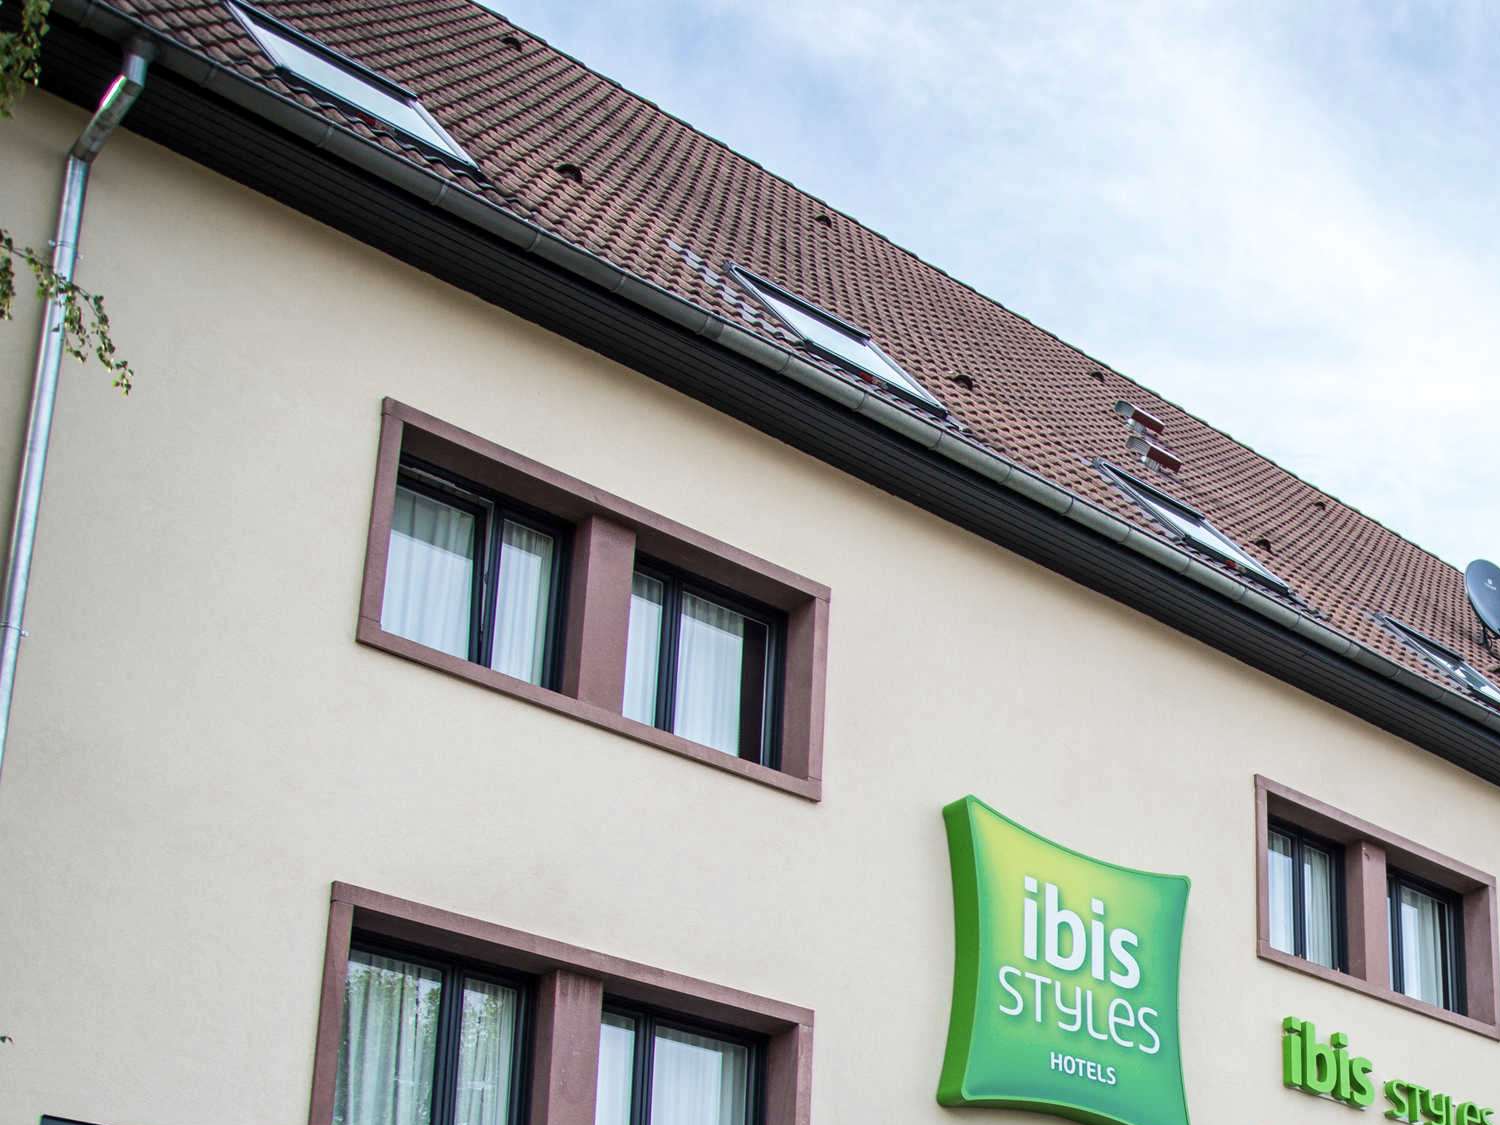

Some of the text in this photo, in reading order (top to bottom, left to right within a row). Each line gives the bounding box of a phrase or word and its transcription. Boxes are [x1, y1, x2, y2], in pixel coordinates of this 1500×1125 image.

[1023, 876, 1140, 989] ibis
[1050, 1052, 1116, 1085] HOTELS
[1283, 1016, 1375, 1108] ibis
